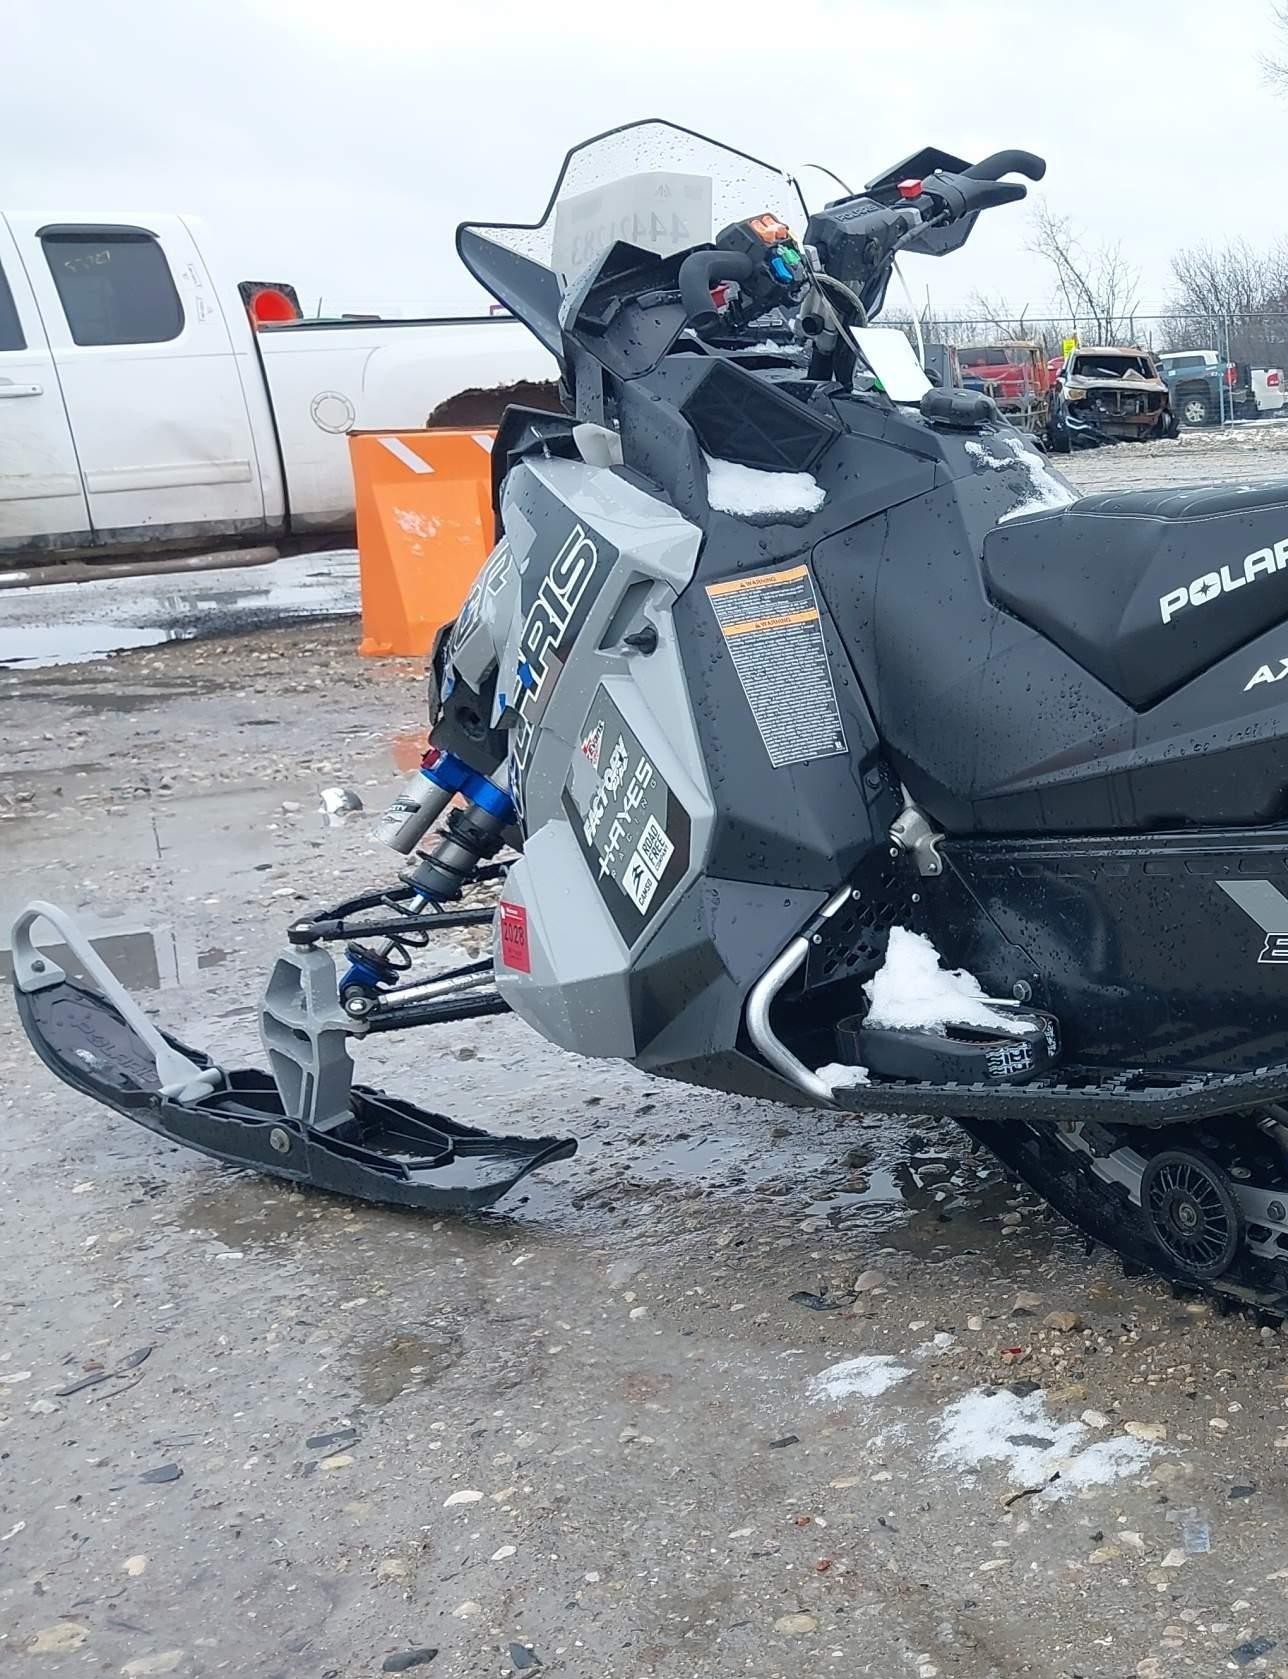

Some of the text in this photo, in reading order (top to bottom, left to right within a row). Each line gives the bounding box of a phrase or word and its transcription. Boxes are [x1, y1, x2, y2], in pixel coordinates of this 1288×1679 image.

[746, 576, 777, 587] WARNING
[760, 617, 791, 627] WARNING
[583, 734, 629, 848] FACTORY
[598, 756, 653, 881] HAYES
[641, 824, 658, 856] ROAD
[648, 835, 665, 866] FREE
[638, 878, 653, 906] CAMSO
